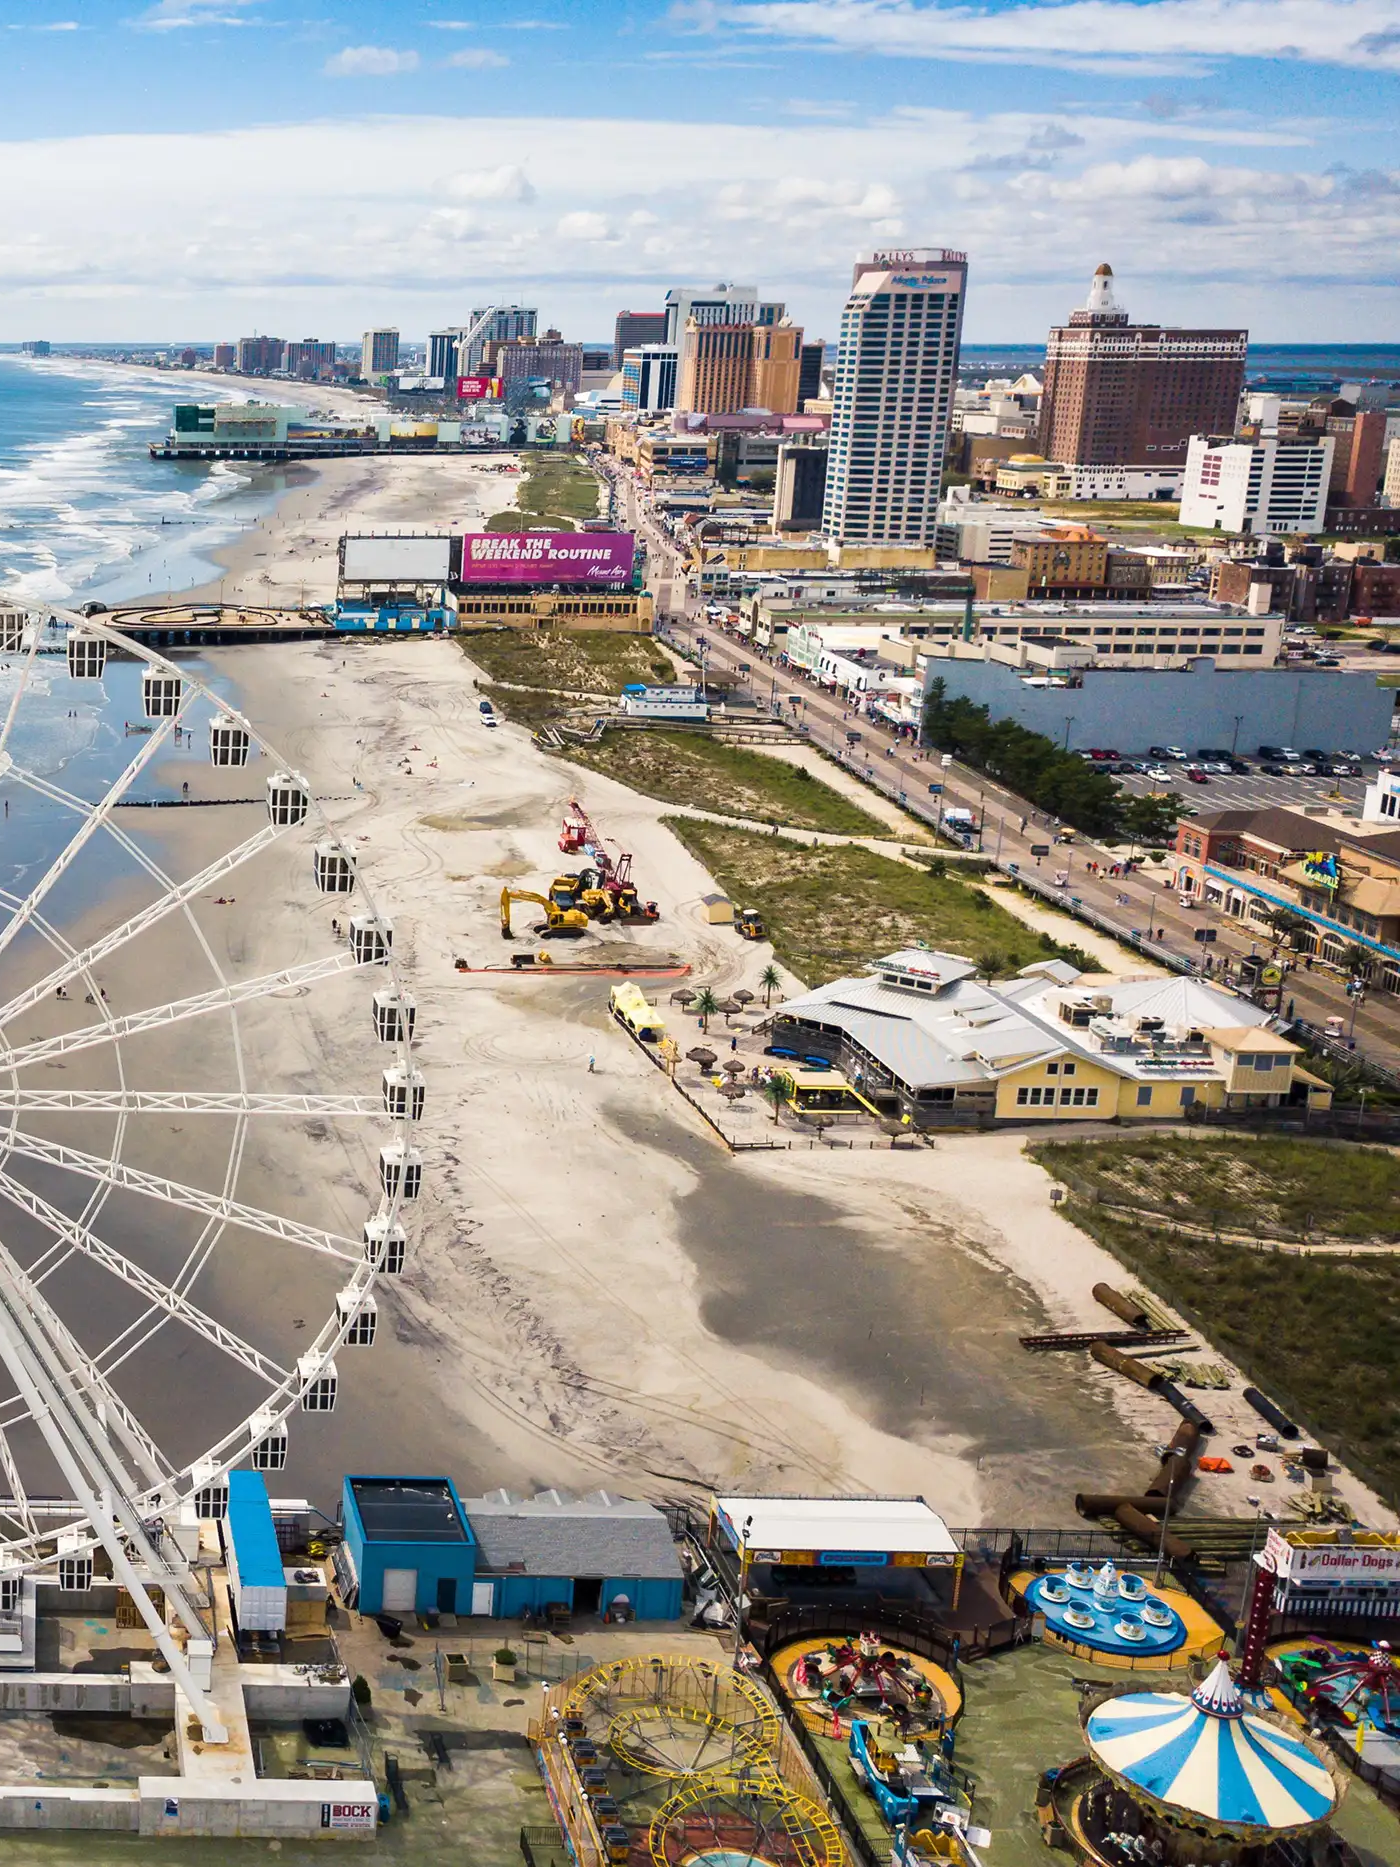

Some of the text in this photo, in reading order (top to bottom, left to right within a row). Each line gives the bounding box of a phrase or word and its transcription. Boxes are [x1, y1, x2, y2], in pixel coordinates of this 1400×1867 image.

[471, 539, 552, 549] BREAK THE
[471, 549, 612, 560] WEEKEND ROUTINE
[1321, 1554, 1394, 1569] Dollar Dogs
[332, 1805, 372, 1817] BOCK
